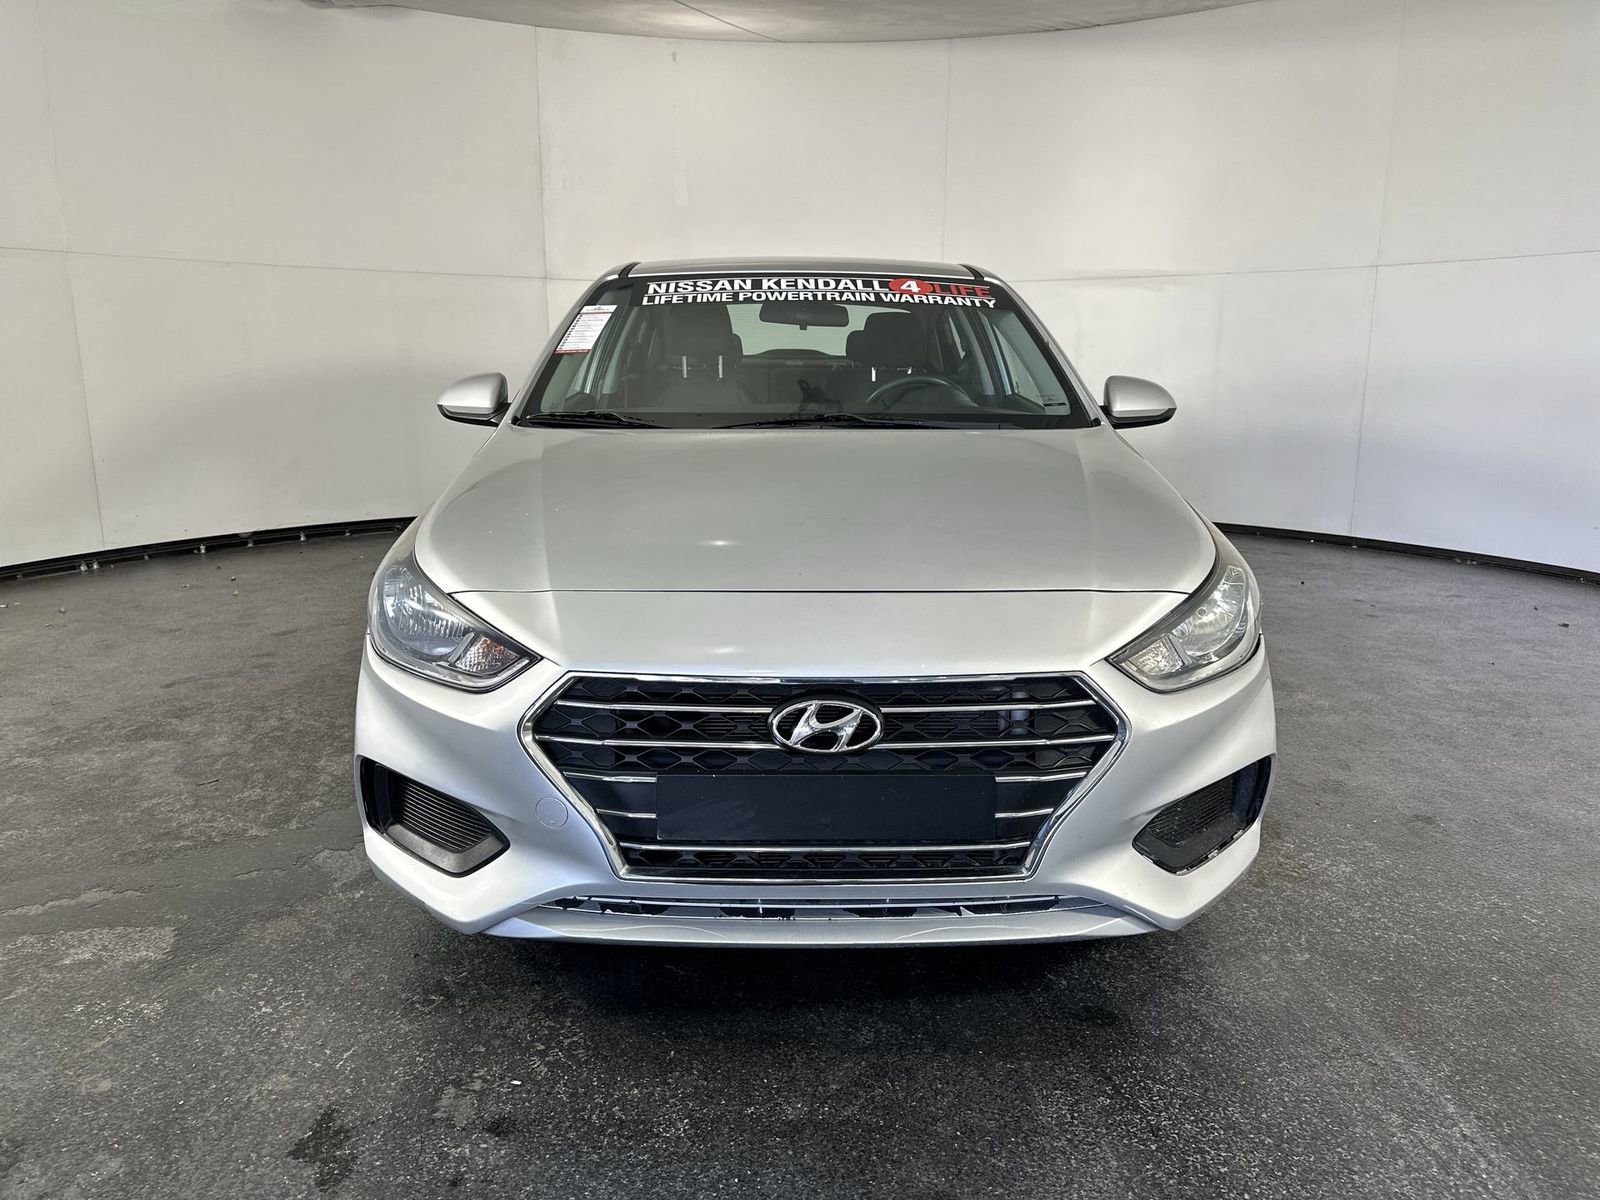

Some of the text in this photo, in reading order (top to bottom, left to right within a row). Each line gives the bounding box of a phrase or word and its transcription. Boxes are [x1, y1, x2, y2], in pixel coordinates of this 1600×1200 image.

[648, 278, 990, 297] NISSAN KENDALL 4 LIFE
[642, 291, 997, 309] LIFETIME POWERTRAIN WARRANTY
